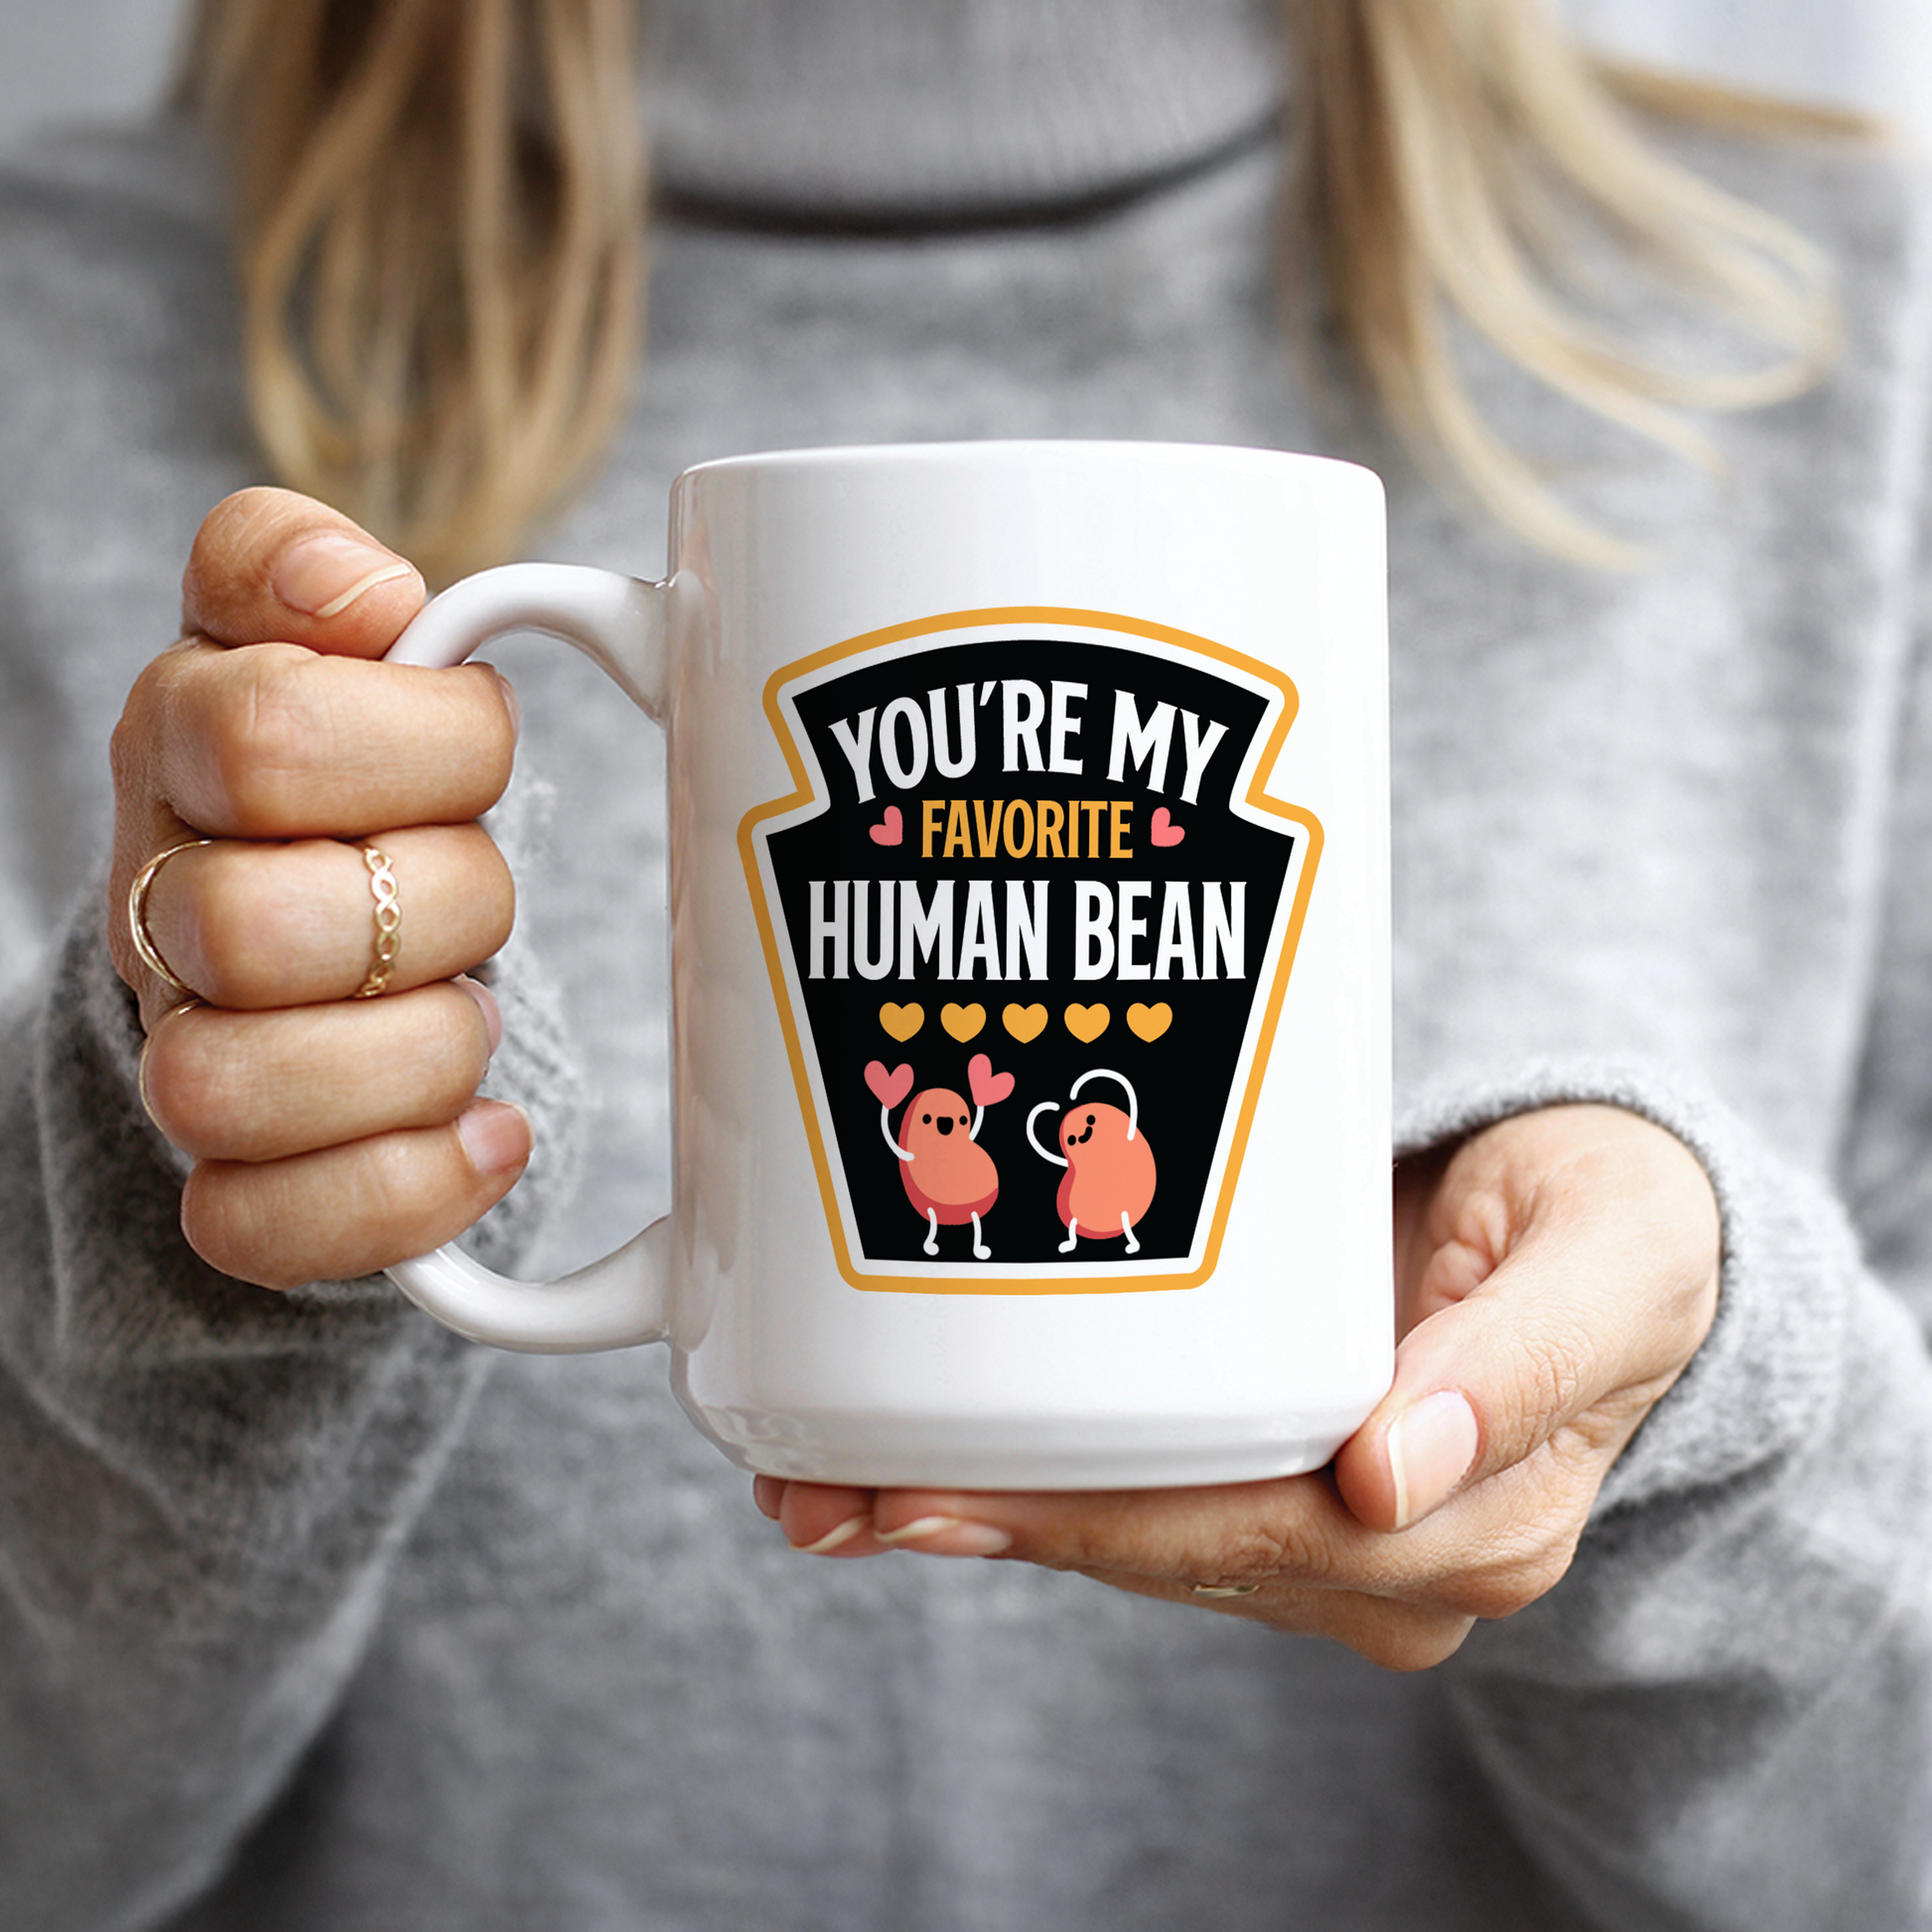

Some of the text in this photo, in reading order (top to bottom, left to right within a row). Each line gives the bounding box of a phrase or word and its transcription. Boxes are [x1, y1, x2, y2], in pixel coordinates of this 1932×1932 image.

[828, 679, 1230, 806] YOU'RE MY
[921, 798, 1134, 859] FAVORITE
[807, 880, 1247, 981] HUMAN BEAN
